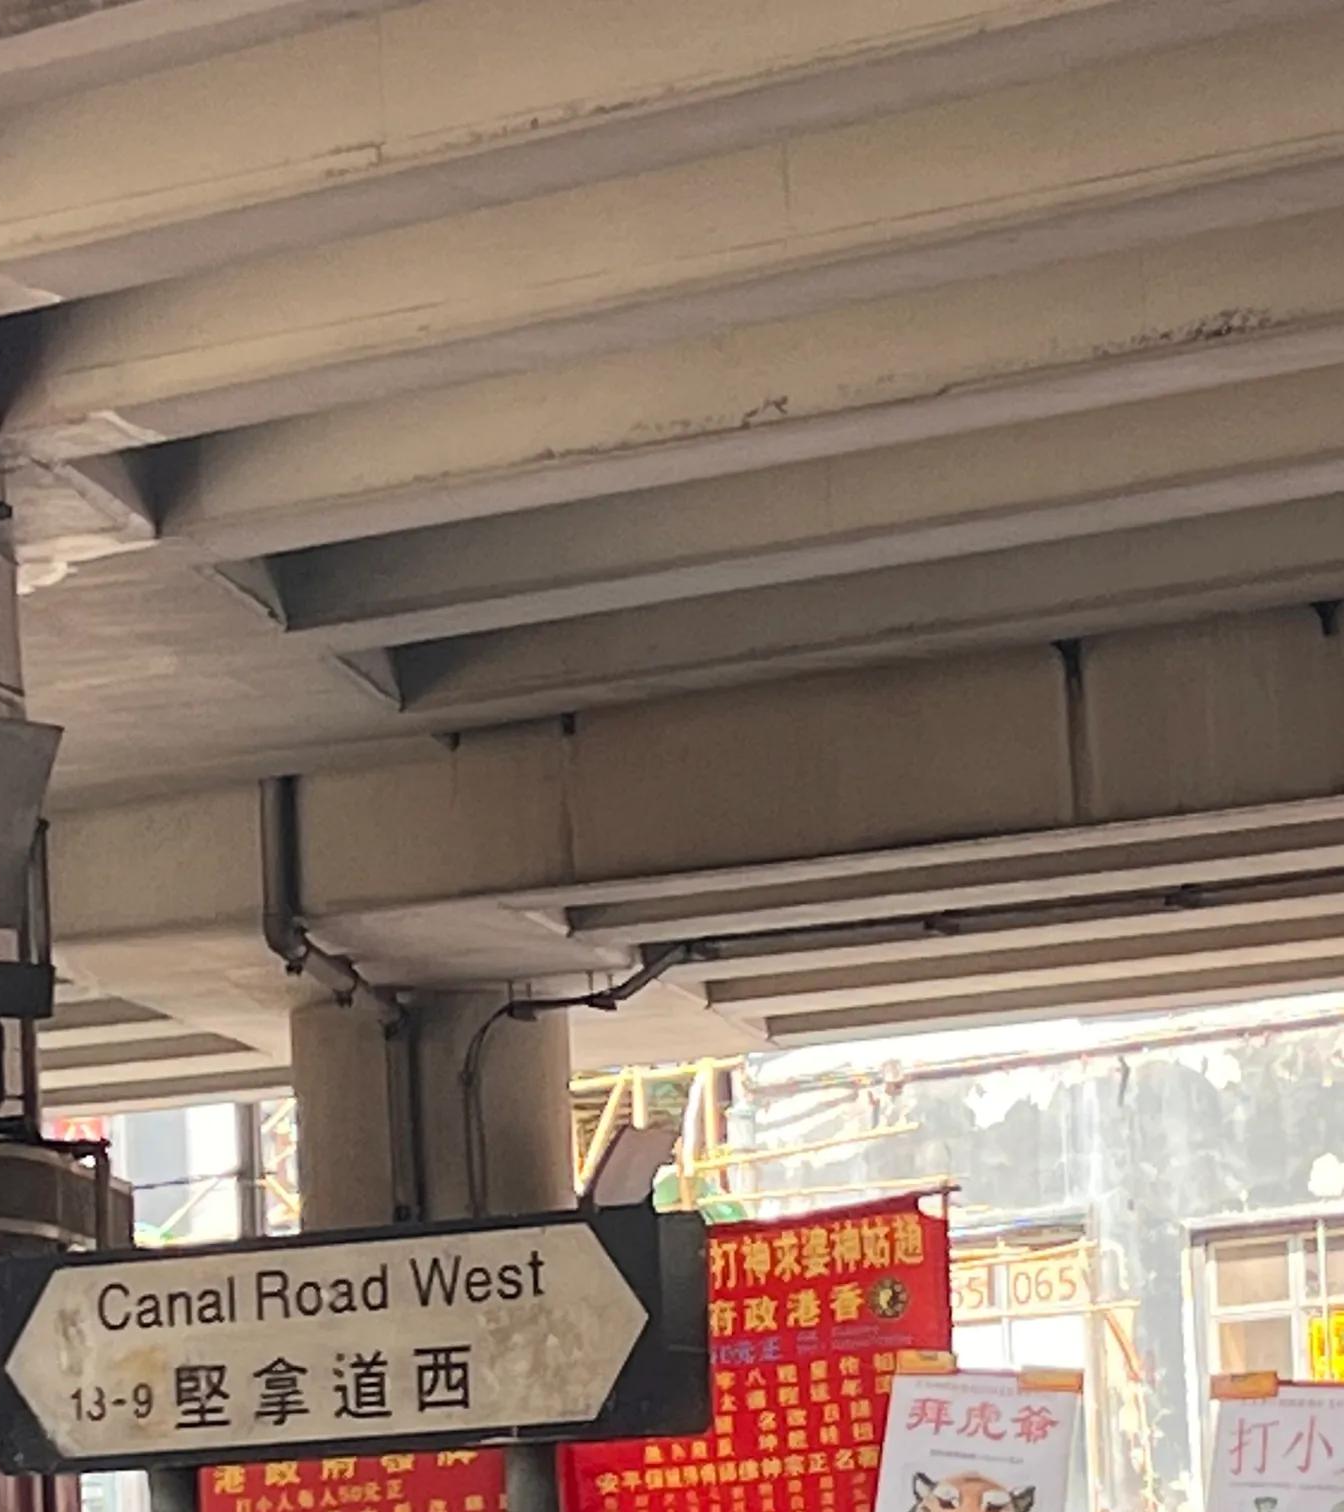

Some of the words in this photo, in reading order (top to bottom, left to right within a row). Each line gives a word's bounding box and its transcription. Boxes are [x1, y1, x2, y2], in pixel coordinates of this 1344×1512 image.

[97, 1278, 236, 1332] Canal
[257, 1264, 390, 1321] Road
[410, 1250, 546, 1308] West
[72, 1383, 154, 1421] 13-9
[173, 1344, 472, 1430] 堅拿道西
[907, 1398, 1060, 1443] 拜虎爺
